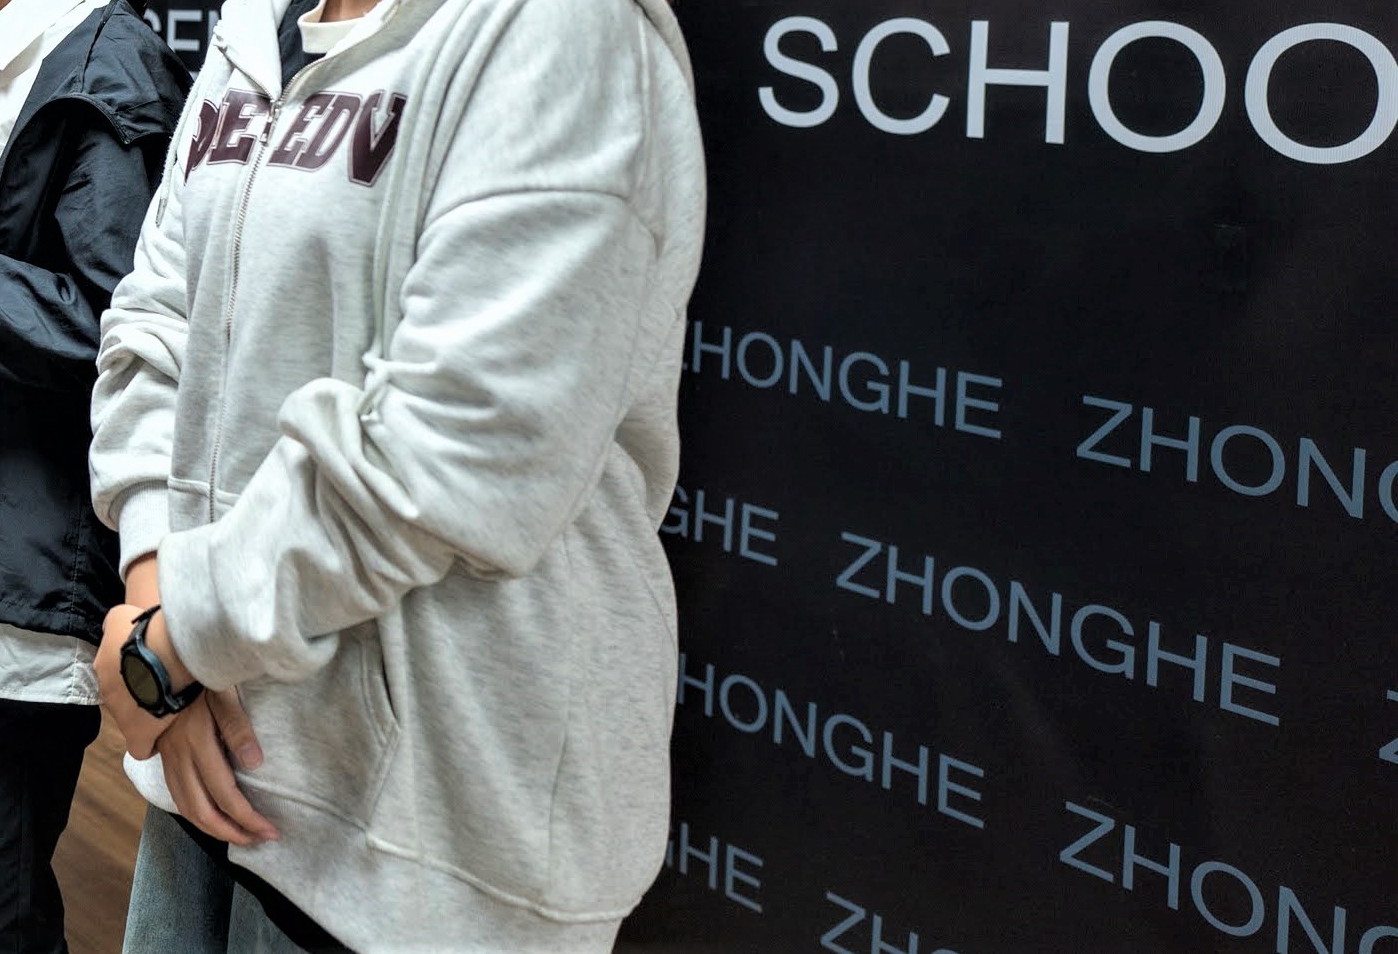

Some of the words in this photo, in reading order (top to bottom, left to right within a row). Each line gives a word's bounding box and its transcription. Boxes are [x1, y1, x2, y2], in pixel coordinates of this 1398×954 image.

[757, 15, 1398, 165] SCHOO
[683, 319, 1002, 439] HONGHE
[835, 531, 1281, 727] ZHONGHE
[1059, 801, 1398, 954] ZHON
